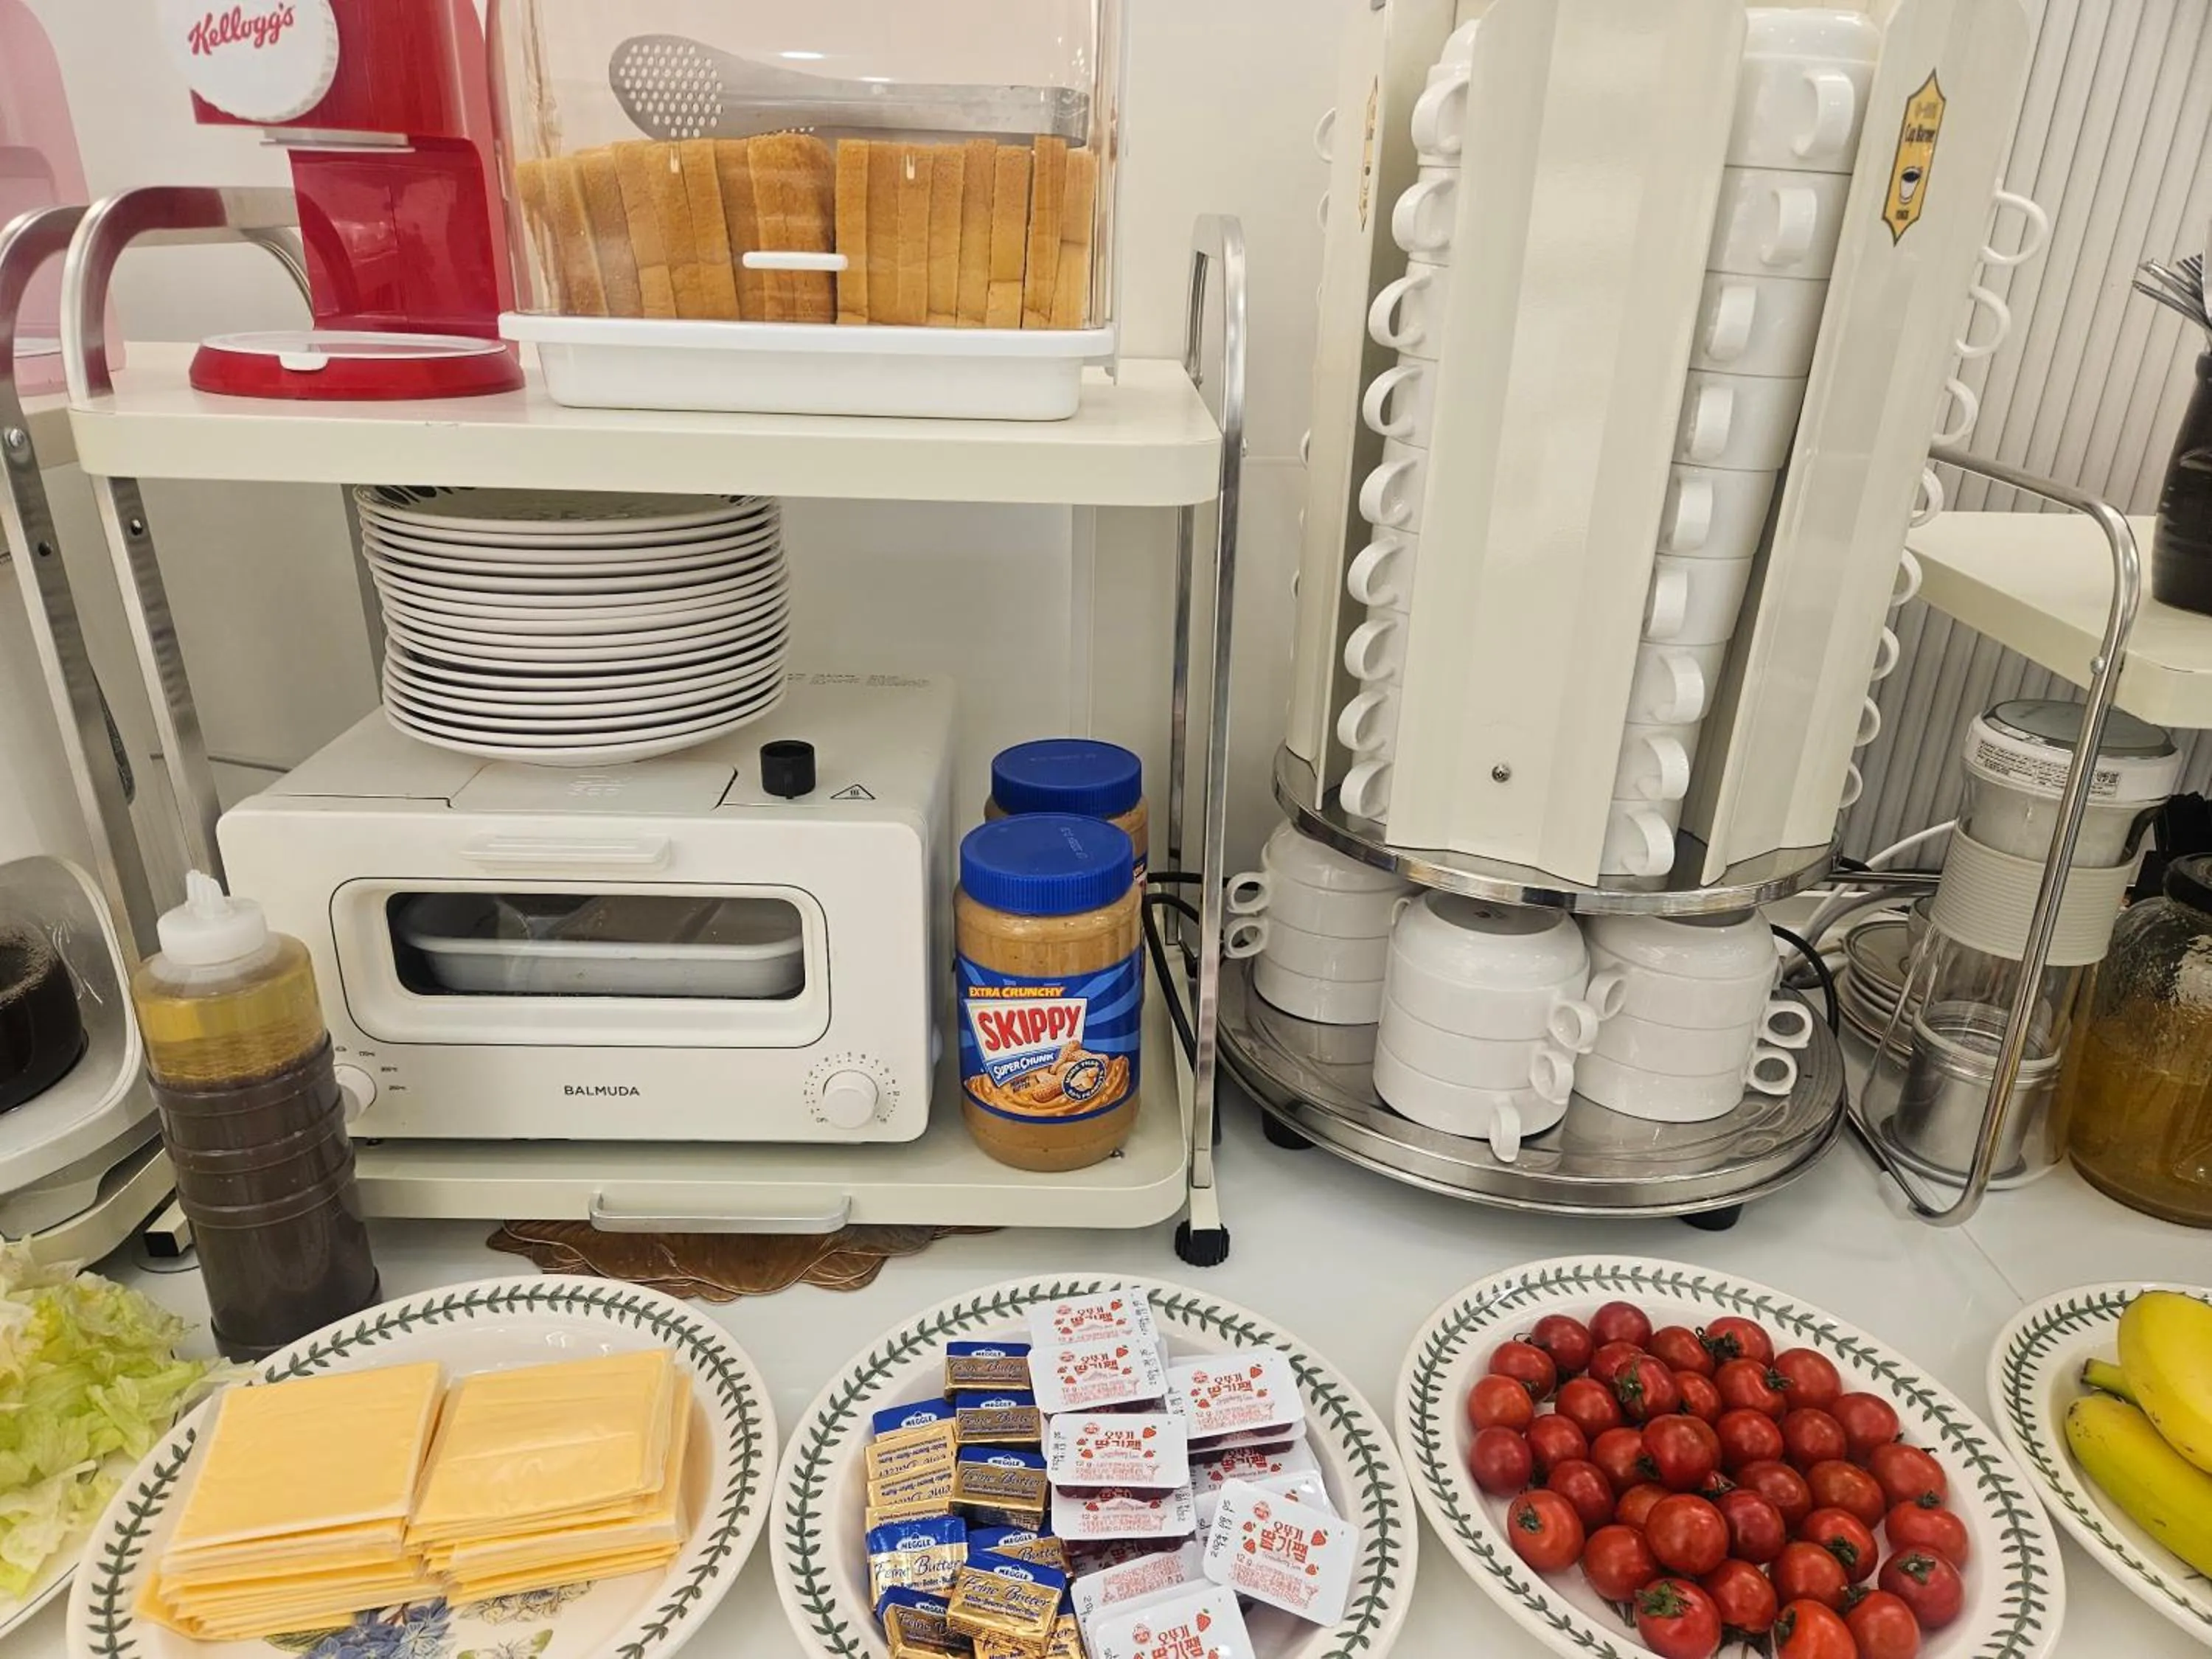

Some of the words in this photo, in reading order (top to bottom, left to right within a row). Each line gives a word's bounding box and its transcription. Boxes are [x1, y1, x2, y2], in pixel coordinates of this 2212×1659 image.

[187, 2, 296, 55] Kellogg's
[969, 987, 1001, 998] EXTRA
[1001, 987, 1065, 998] CRUNCHY
[977, 1005, 1082, 1052] SKIPPY
[564, 1085, 640, 1096] BALMUDA
[905, 1415, 933, 1426] MEGGLE
[992, 1459, 1020, 1467] MEGGLE
[1274, 1521, 1304, 1541] 오뚜기
[901, 1539, 931, 1550] MEGGLE
[1004, 1535, 1032, 1545] MEGGLE
[914, 1555, 961, 1575] Butter
[998, 1569, 1029, 1580] MEGGLE
[1005, 1585, 1050, 1607] Butter
[1158, 1624, 1189, 1645] 오뚜기
